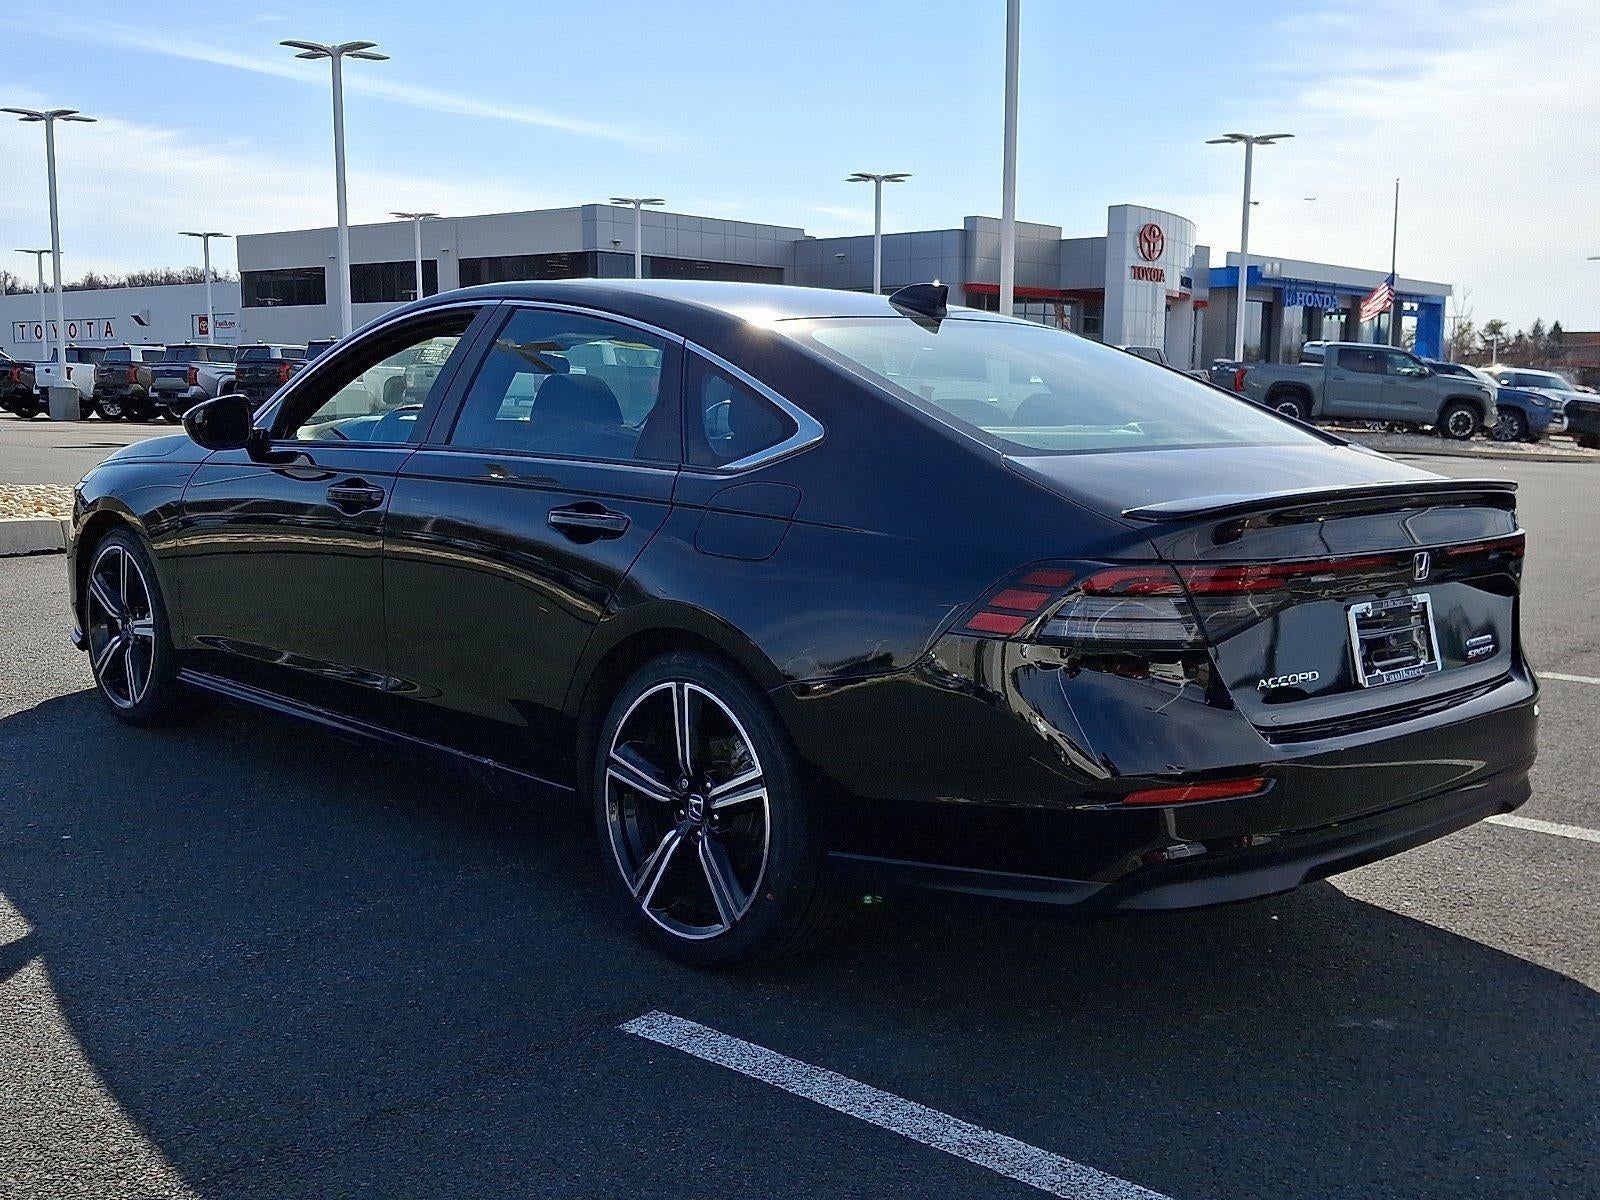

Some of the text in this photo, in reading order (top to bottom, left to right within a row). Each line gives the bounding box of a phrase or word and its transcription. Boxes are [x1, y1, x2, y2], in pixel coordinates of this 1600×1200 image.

[1131, 266, 1165, 282] TOYOTA
[1295, 292, 1338, 309] HONDA
[19, 321, 114, 340] TOYOTA
[1256, 670, 1320, 690] ACCORD
[1382, 667, 1424, 683] Faulkner
